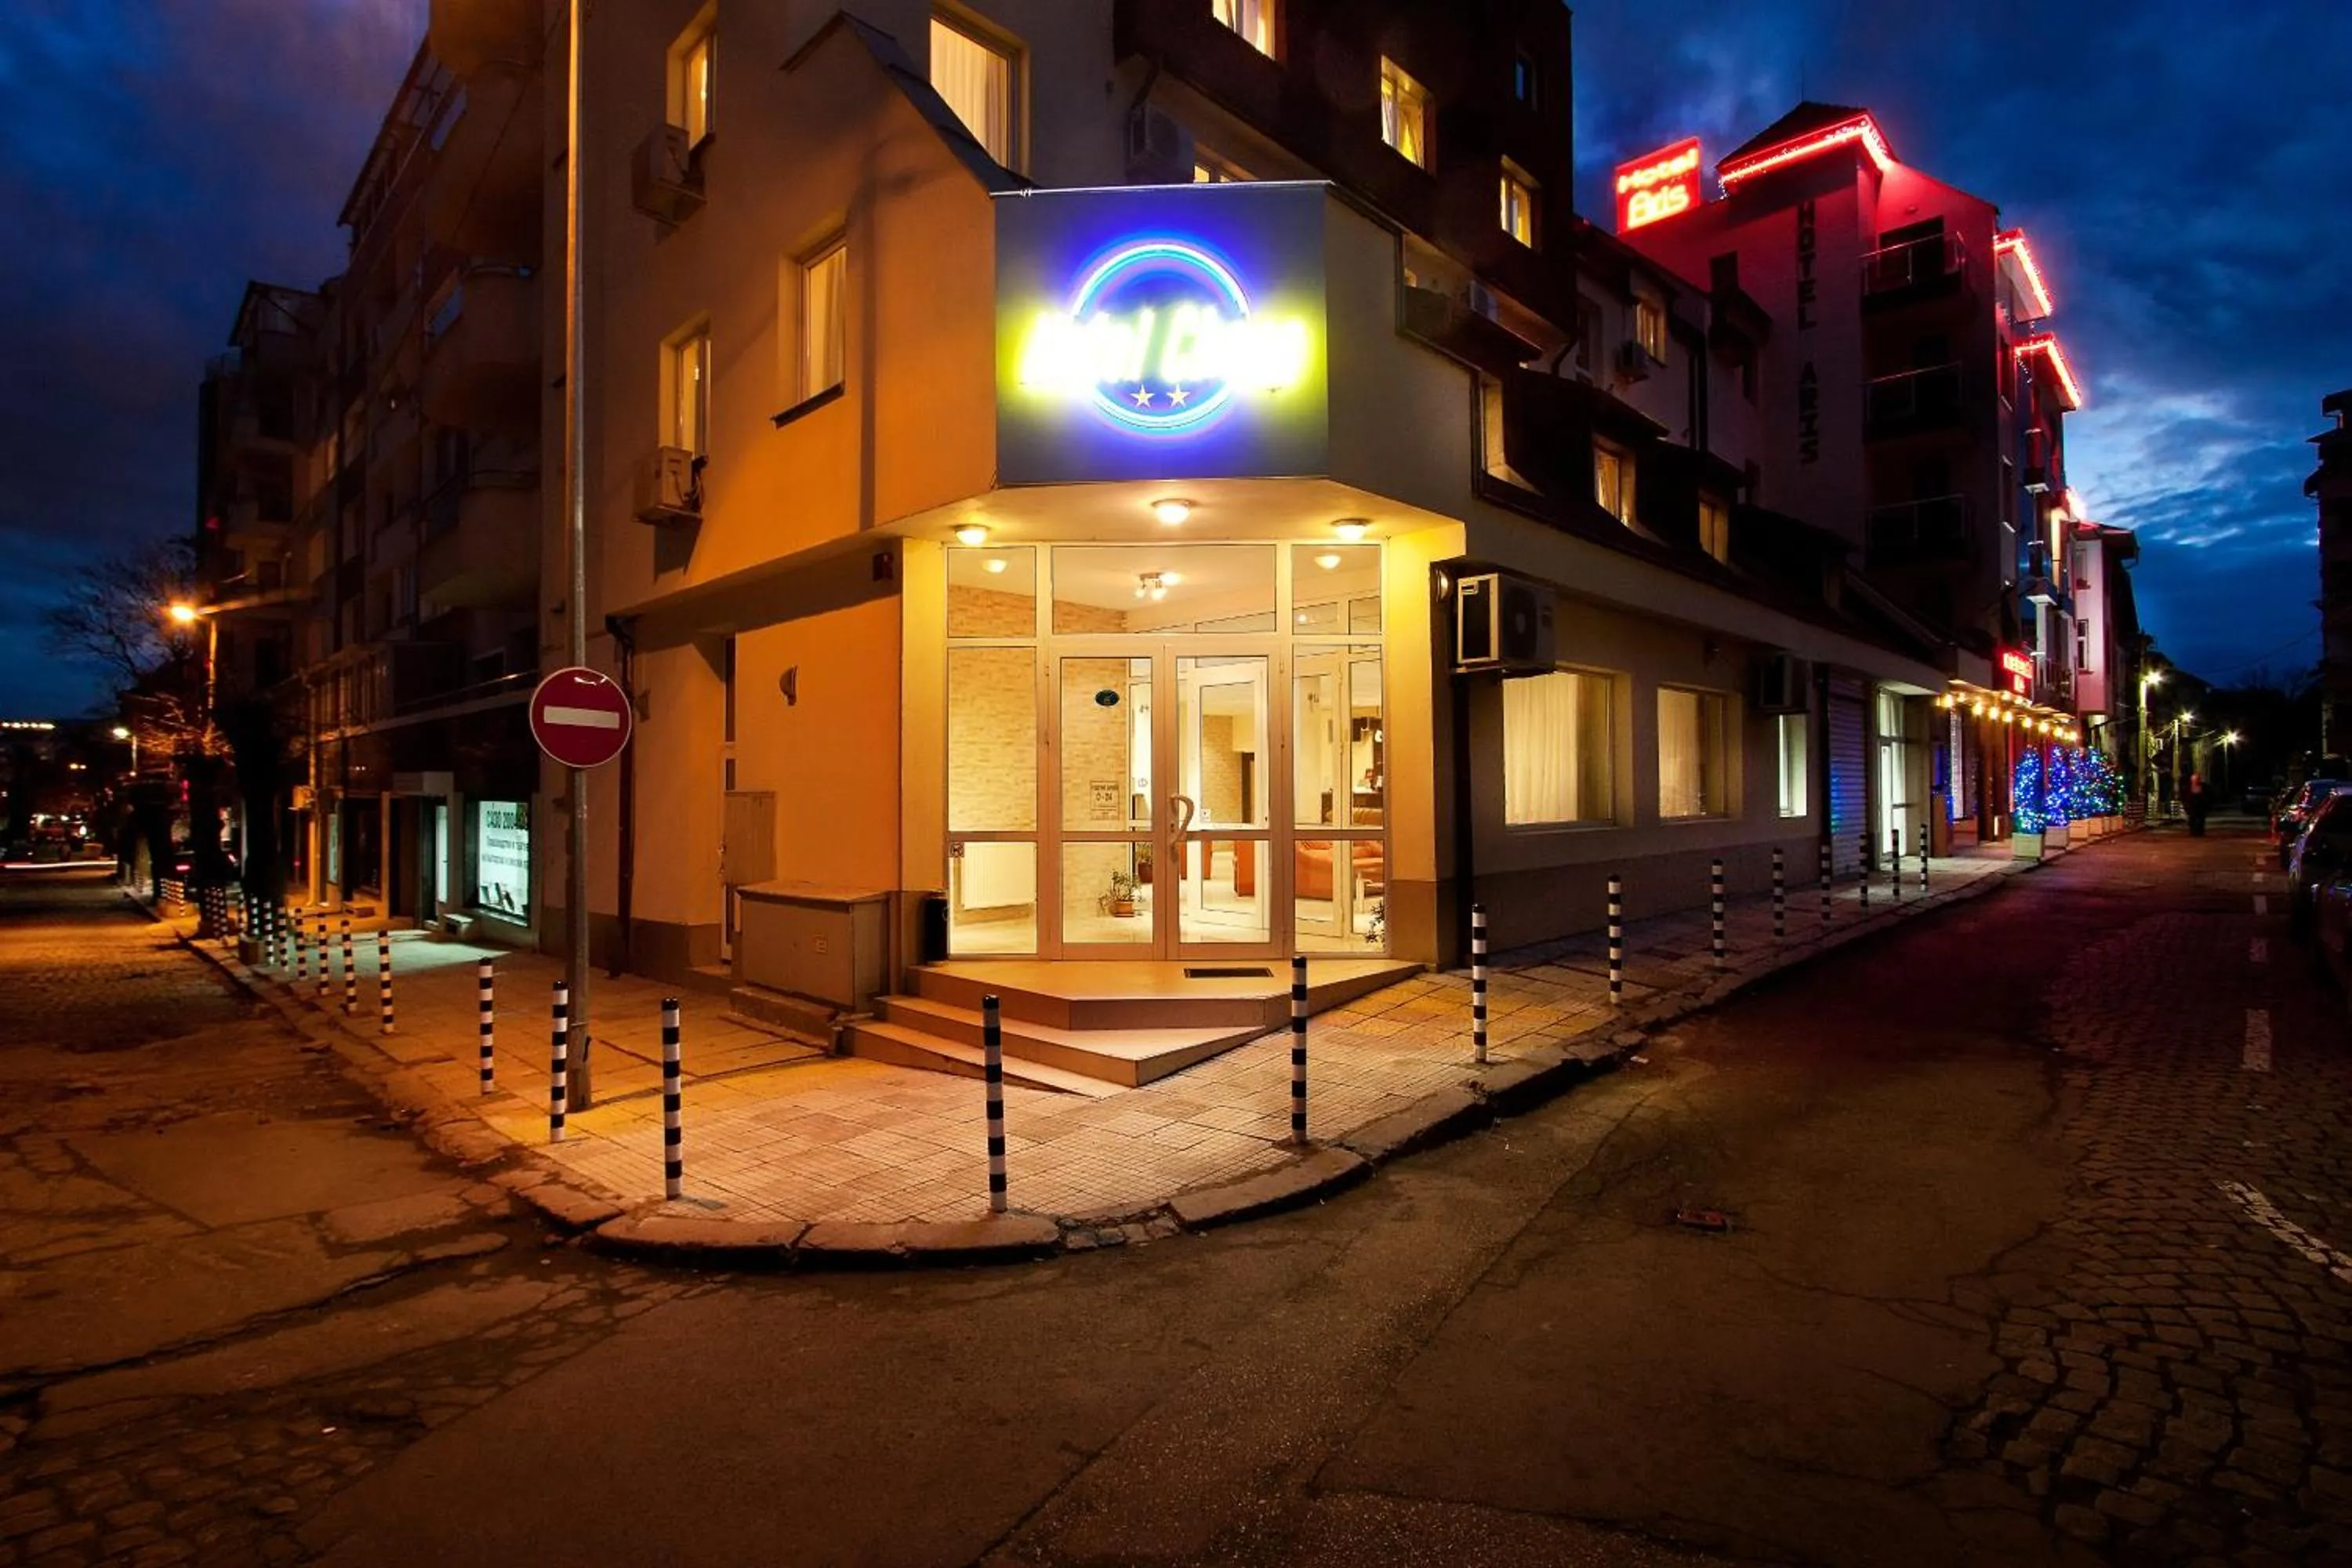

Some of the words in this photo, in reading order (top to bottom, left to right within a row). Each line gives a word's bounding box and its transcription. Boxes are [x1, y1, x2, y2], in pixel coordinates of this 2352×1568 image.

[1617, 147, 1699, 194] Hotel
[1798, 200, 1817, 331] HOTEL
[1798, 361, 1819, 464] ARIS
